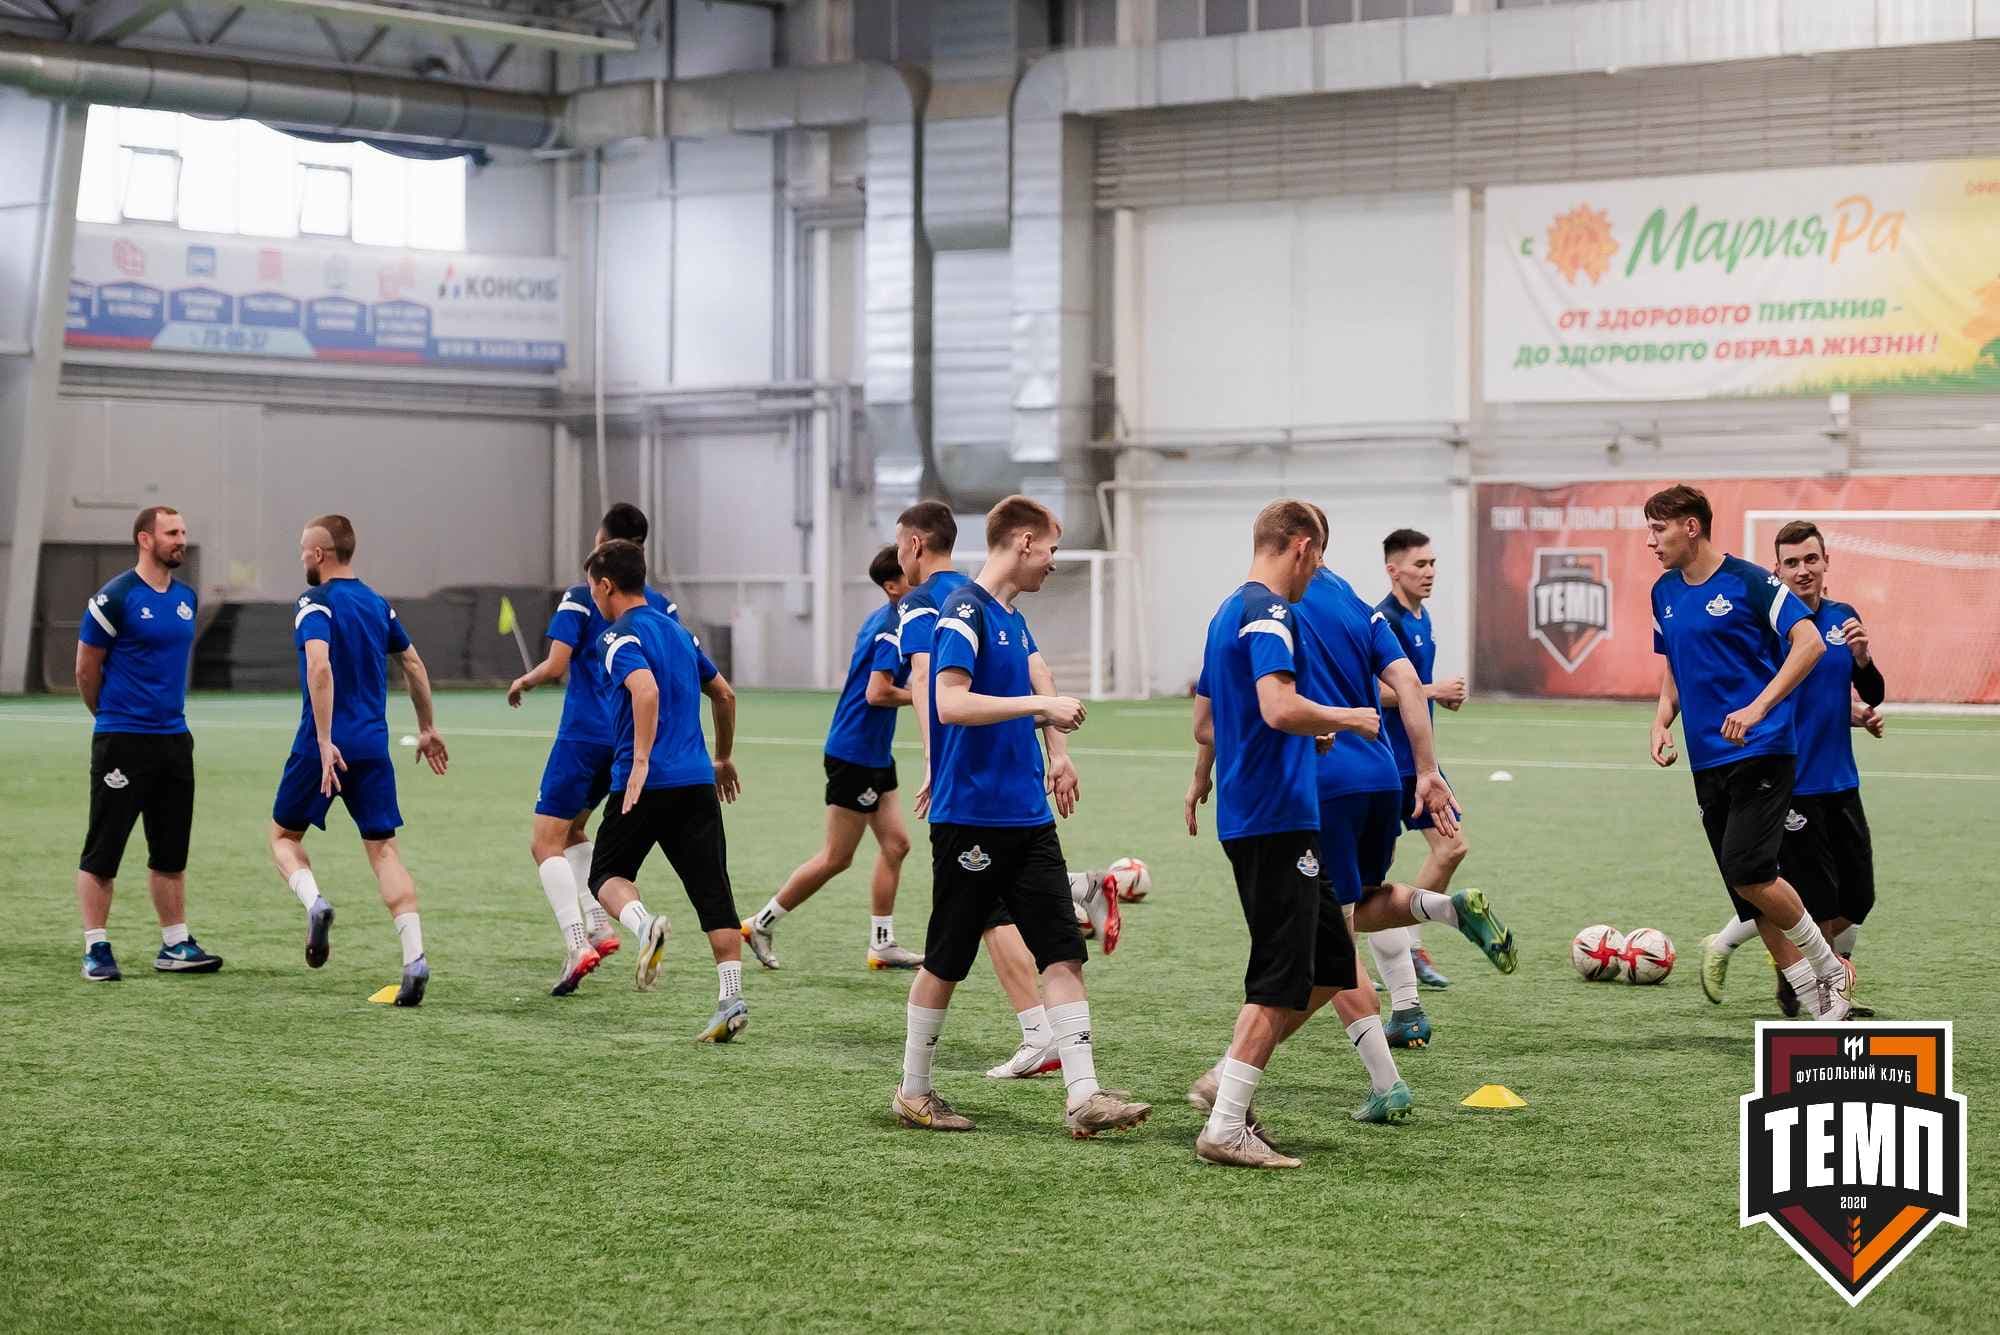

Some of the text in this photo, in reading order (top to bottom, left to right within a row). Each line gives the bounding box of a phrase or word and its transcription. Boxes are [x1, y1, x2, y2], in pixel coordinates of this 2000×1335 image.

[464, 275, 560, 299] КОНСИБ
[1559, 309, 1590, 330] ОТ
[1597, 304, 1750, 330] ЗДОРОВОГО
[1758, 299, 1886, 321] ПИТАНИЯ
[1514, 345, 1549, 368] ДО
[1556, 342, 1707, 367] ЗДОРОВОГО
[1715, 337, 1814, 360] ОБРАЗА
[1535, 581, 1606, 626] ТЕМП
